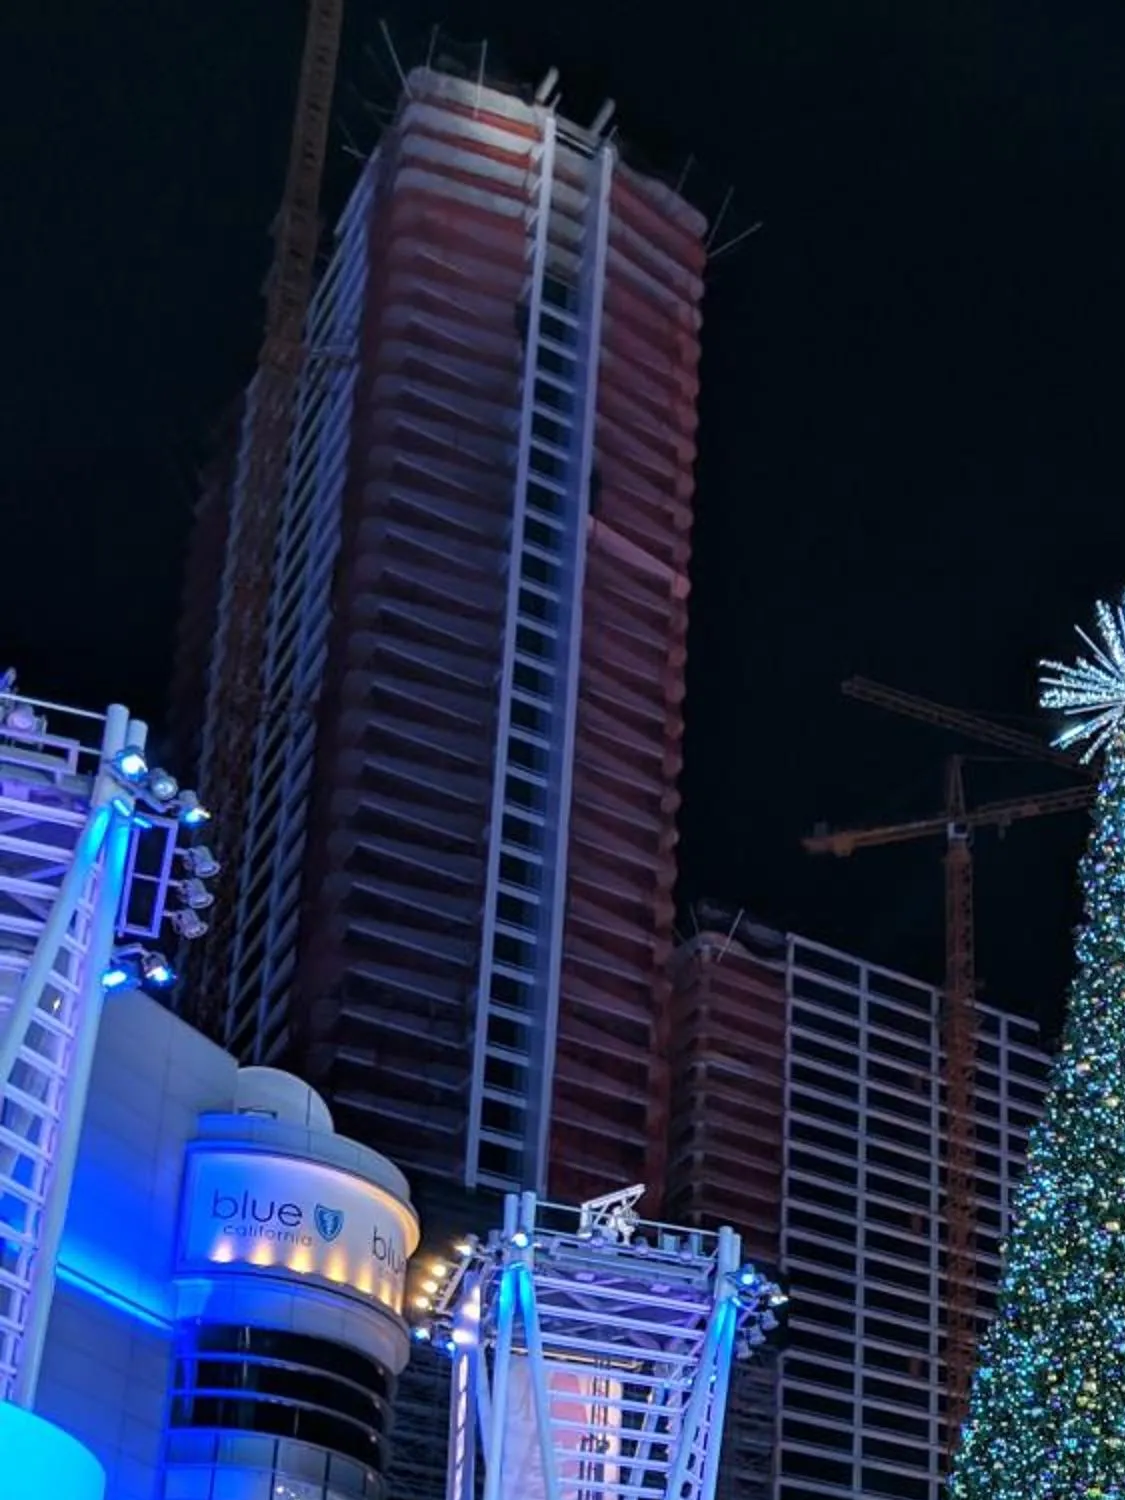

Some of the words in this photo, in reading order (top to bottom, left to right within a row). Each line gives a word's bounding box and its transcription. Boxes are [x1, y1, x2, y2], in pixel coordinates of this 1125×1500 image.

[212, 1189, 302, 1227] blue
[222, 1222, 313, 1248] california
[372, 1225, 404, 1275] blu
